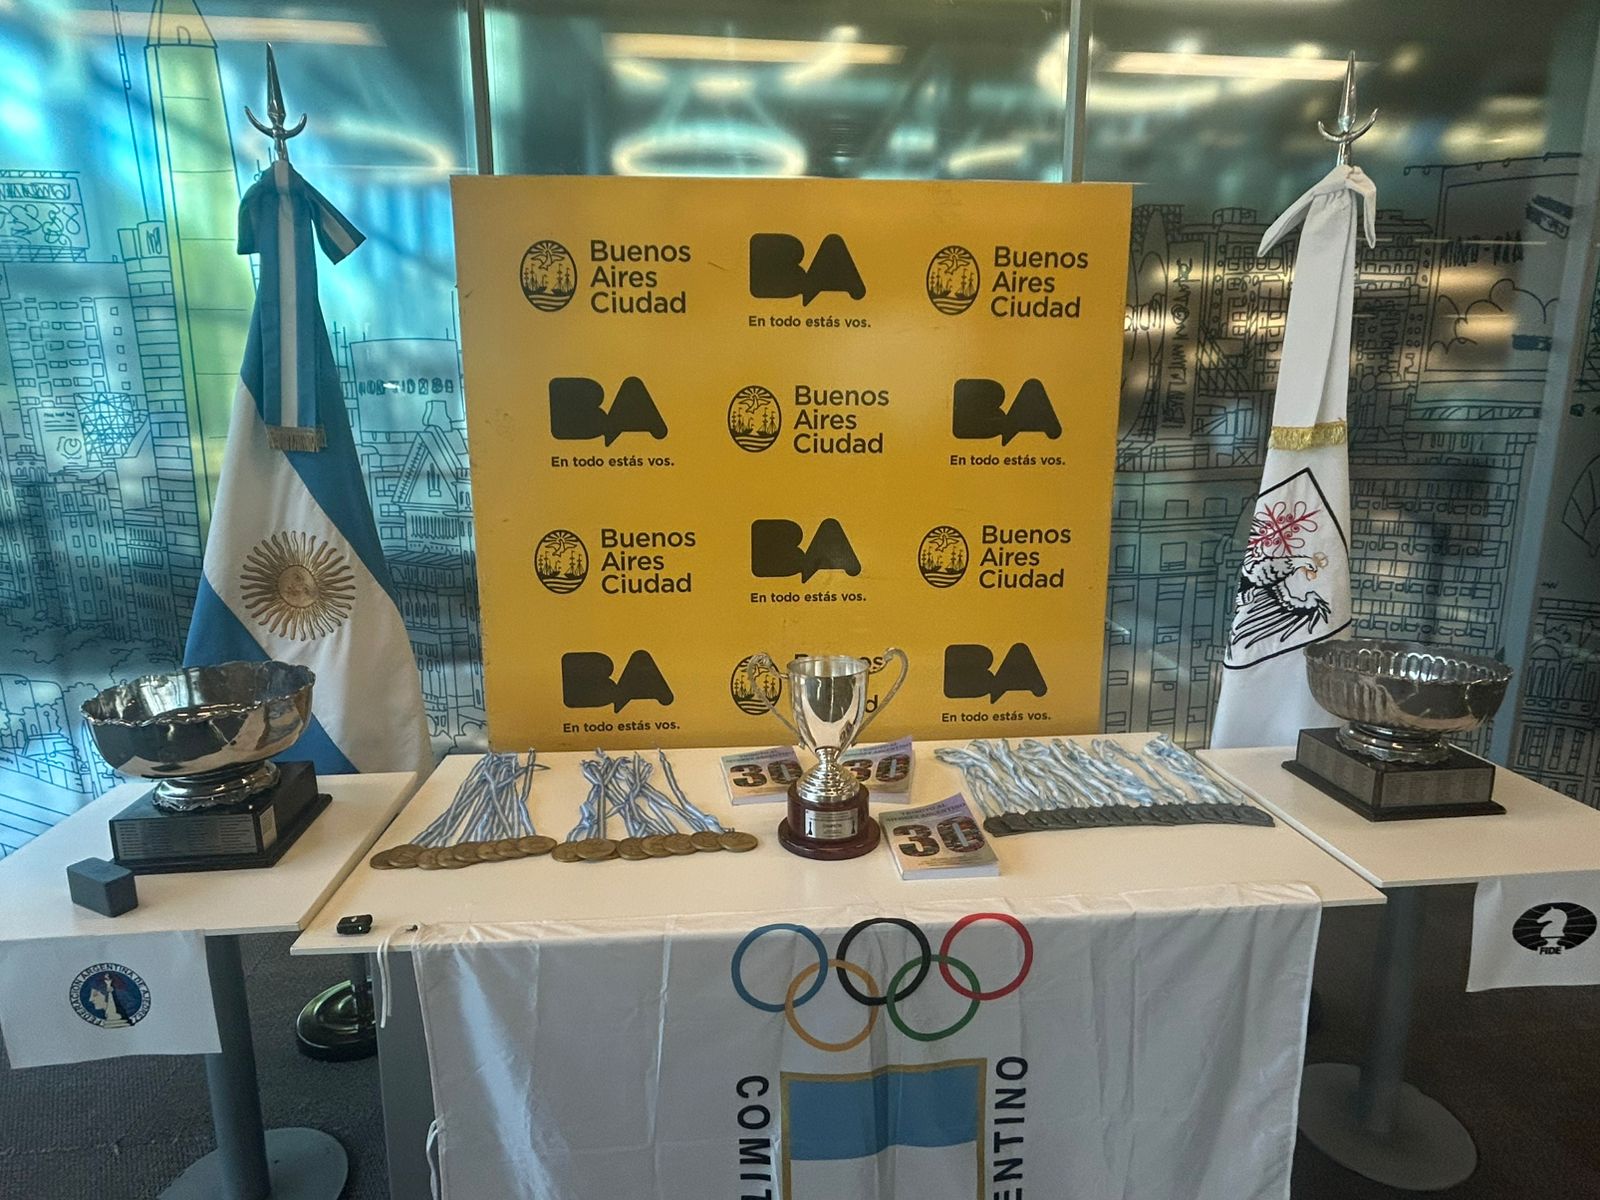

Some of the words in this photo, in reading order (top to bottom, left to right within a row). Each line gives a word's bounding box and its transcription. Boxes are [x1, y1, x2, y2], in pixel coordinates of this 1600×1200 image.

[591, 240, 691, 262] Buenos
[995, 246, 1088, 268] Buenos
[591, 265, 657, 287] Aires
[750, 234, 866, 307] BA
[992, 271, 1054, 293] Aires
[591, 291, 685, 313] Ciudad
[991, 295, 1080, 318] Ciudad
[749, 316, 765, 326] En
[770, 316, 801, 327] todo
[806, 316, 839, 327] estás
[845, 319, 871, 328] vos.
[795, 385, 889, 406] Buenos
[549, 377, 668, 447] BA
[794, 409, 857, 429] Aires
[953, 379, 1062, 446] BA
[794, 433, 883, 453] Ciudad
[552, 457, 568, 467] En
[573, 456, 604, 467] todo
[609, 456, 643, 466] estás
[648, 458, 675, 466] vos.
[951, 455, 966, 465] En
[971, 455, 999, 465] todo
[1004, 455, 1036, 465] estás
[1041, 457, 1065, 466] vos.
[602, 529, 695, 548] Buenos
[982, 525, 1071, 544] Buenos
[601, 551, 664, 571] Aires
[751, 518, 861, 583] BA
[980, 547, 1039, 566] Aires
[602, 573, 691, 594] Ciudad
[979, 569, 1064, 588] Ciudad
[751, 593, 766, 602] En
[771, 592, 800, 602] todo
[805, 592, 837, 602] estás
[842, 594, 866, 602] vos.
[562, 650, 674, 713] BA
[944, 643, 1047, 704] BA
[563, 723, 579, 733] En
[584, 722, 613, 732] todo
[618, 720, 650, 731] estás
[655, 722, 680, 730] vos.
[942, 713, 956, 722] En
[961, 712, 988, 721] todo
[993, 711, 1023, 721] estás
[1028, 713, 1051, 721] vos.
[893, 816, 985, 857] 30
[1539, 946, 1562, 955] FIDE
